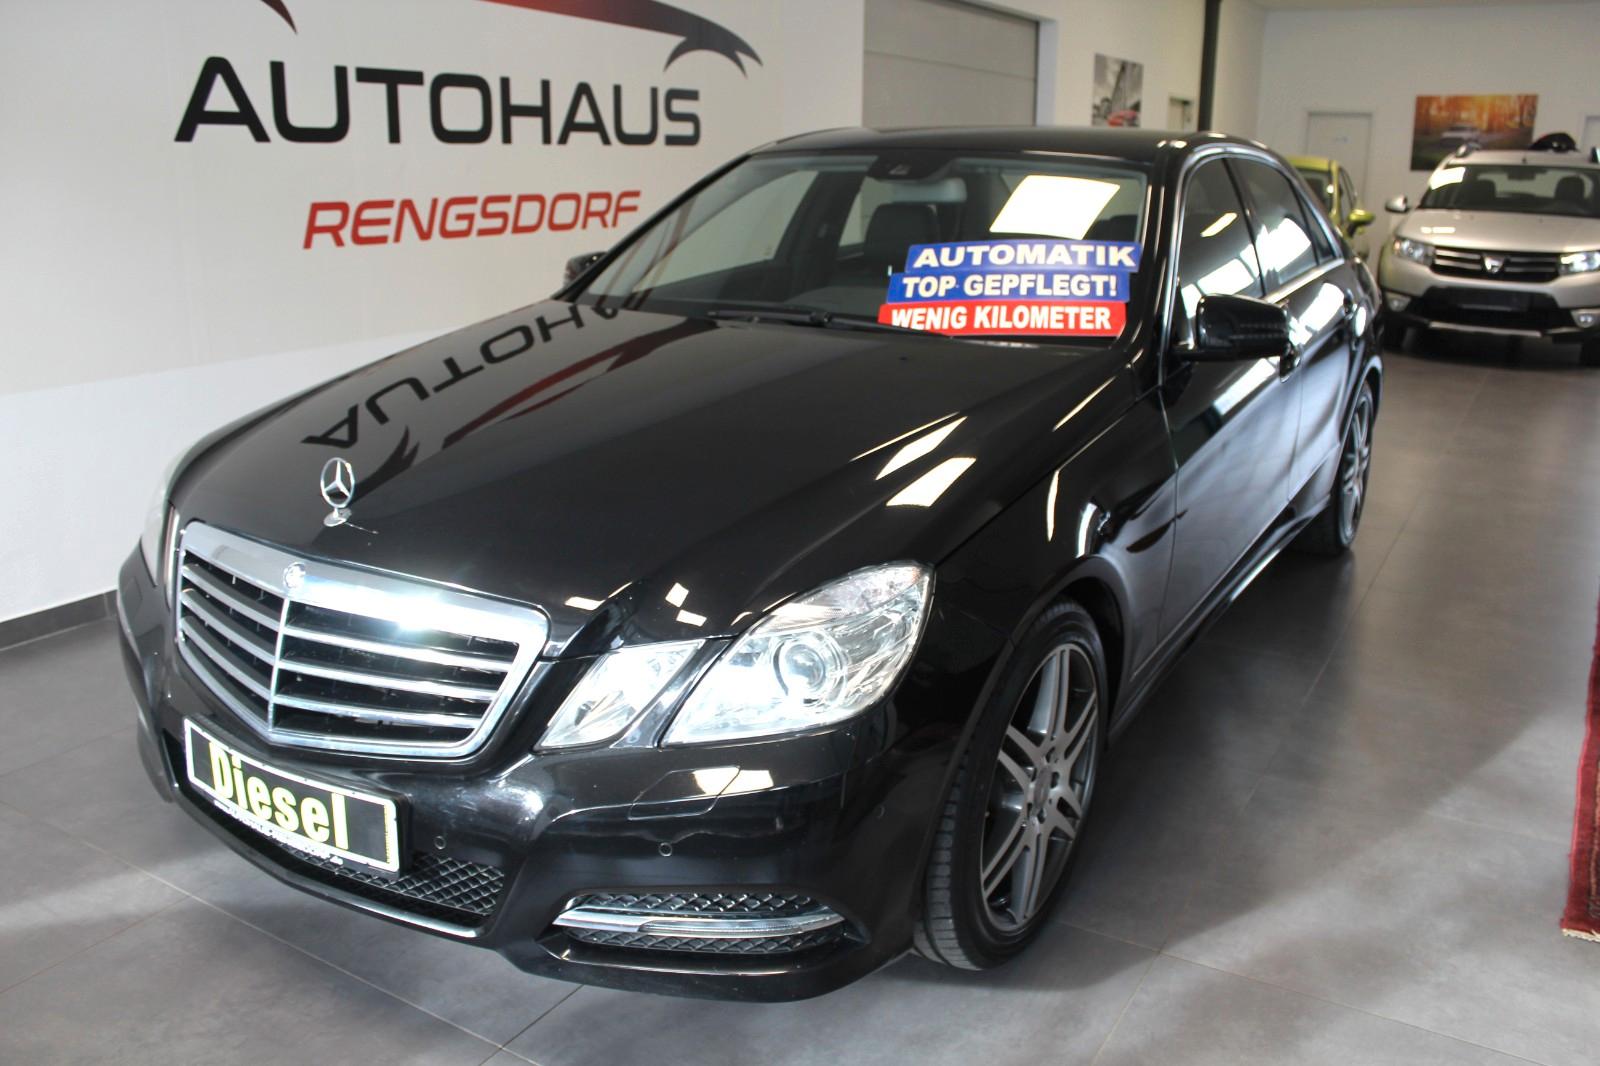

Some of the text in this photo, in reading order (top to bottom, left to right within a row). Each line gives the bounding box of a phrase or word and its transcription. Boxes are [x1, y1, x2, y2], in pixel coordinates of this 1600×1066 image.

[174, 56, 701, 146] AUTOHAUS
[303, 190, 641, 250] RENGSDORF
[913, 243, 1136, 269] AUTOMATIK
[902, 274, 1117, 298] TOP GEPFLEGT!
[891, 305, 1112, 331] WENIG KILOMETER
[208, 741, 349, 850] Diesel
